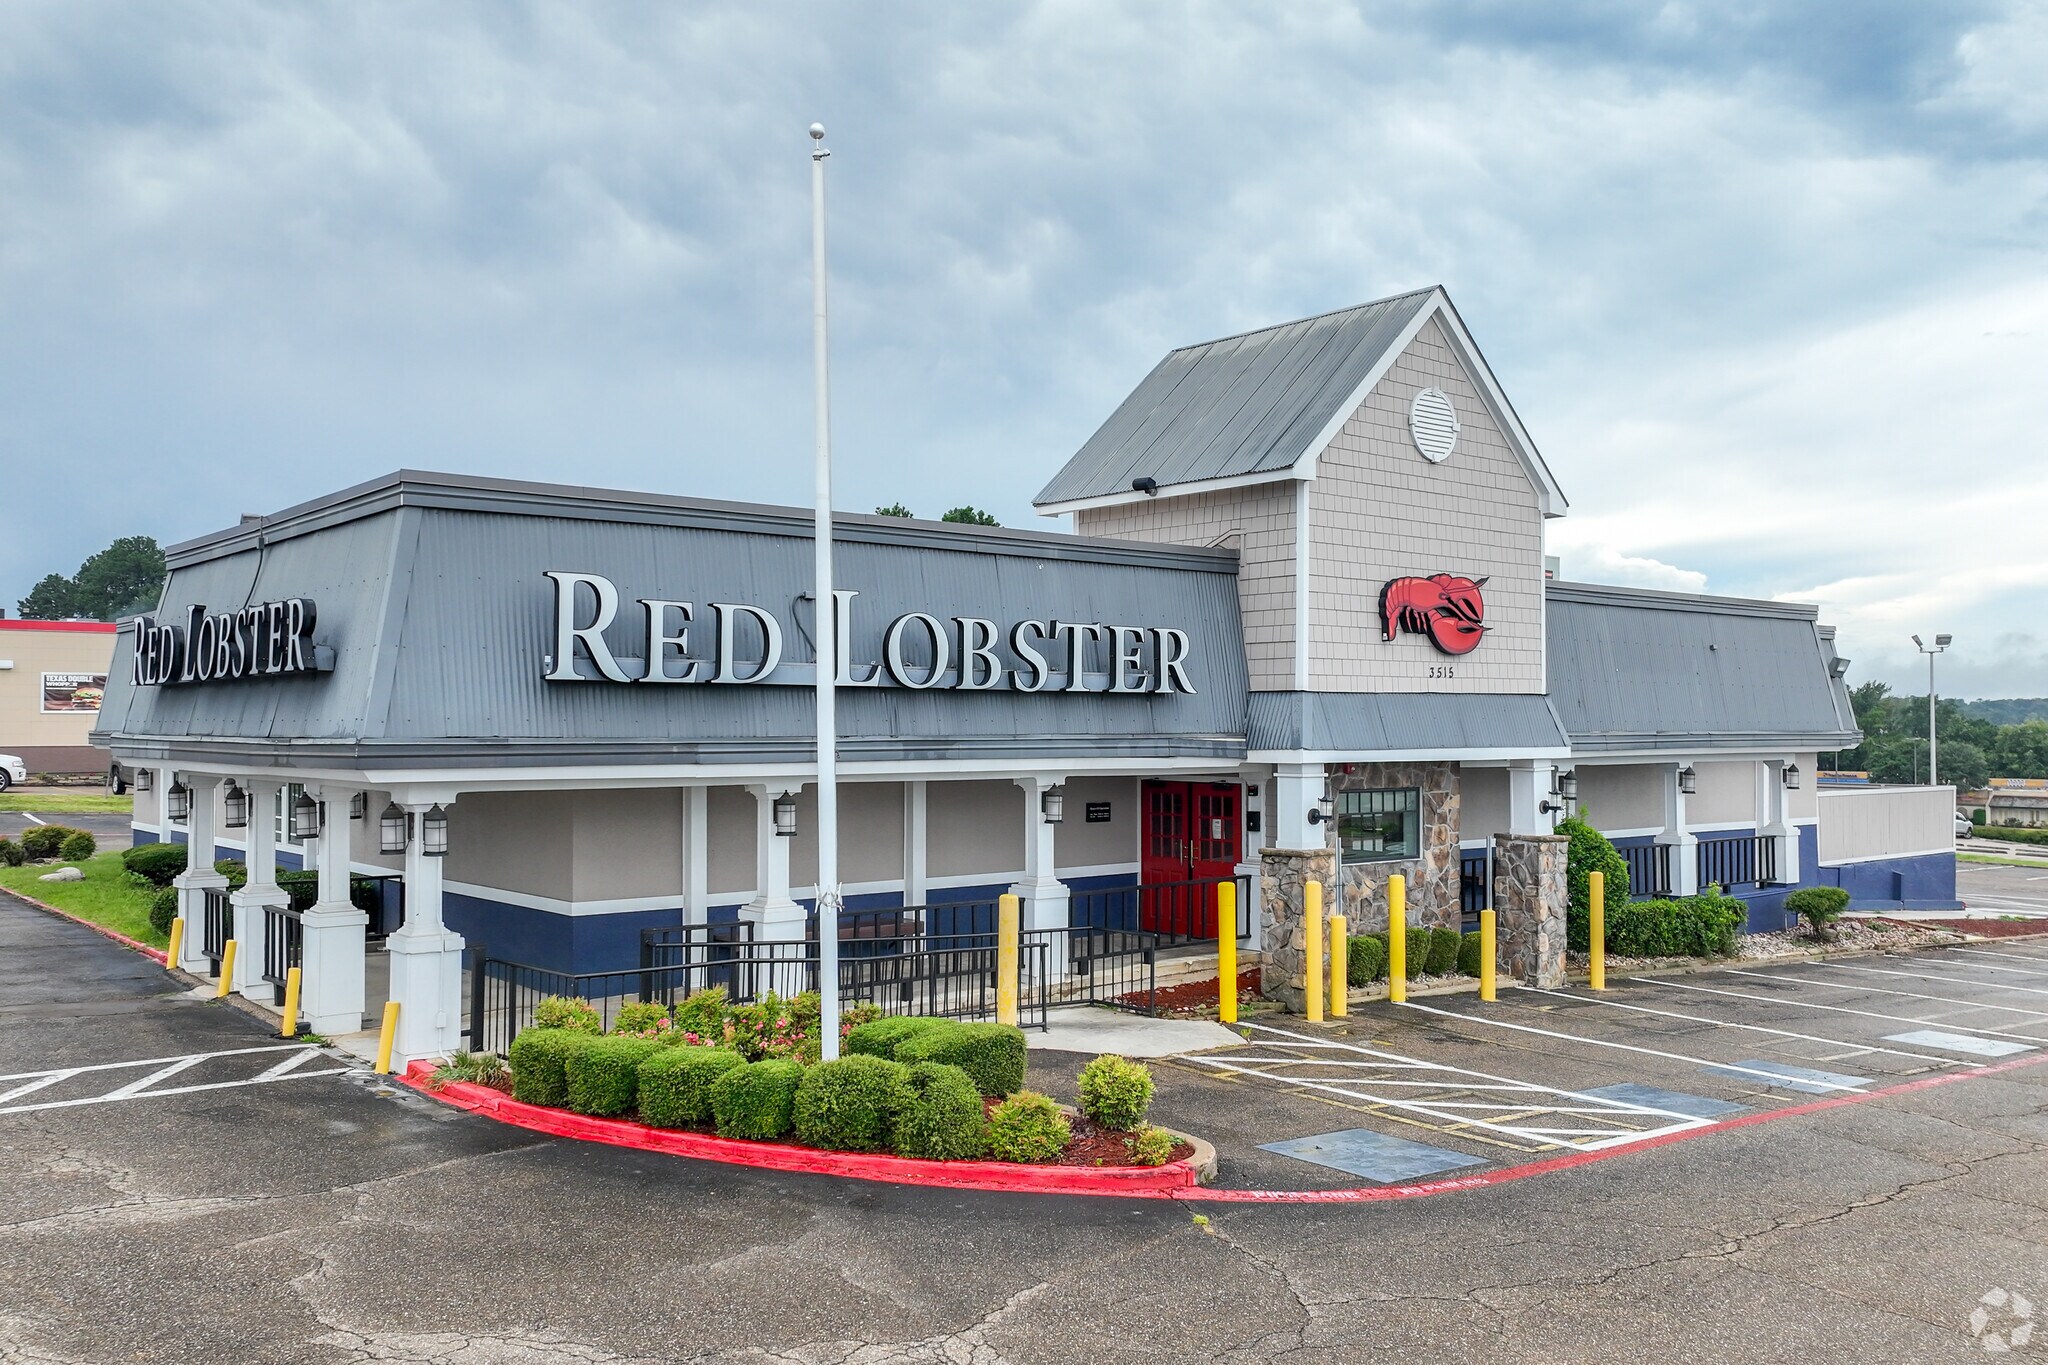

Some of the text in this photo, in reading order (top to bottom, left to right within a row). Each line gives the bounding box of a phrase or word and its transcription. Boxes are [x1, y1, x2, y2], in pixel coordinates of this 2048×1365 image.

[130, 599, 308, 686] RED LOBSTER
[543, 571, 1197, 694] RED LOBSTER
[45, 675, 93, 683] TEXAS DOUBLE
[1429, 666, 1454, 679] 3515
